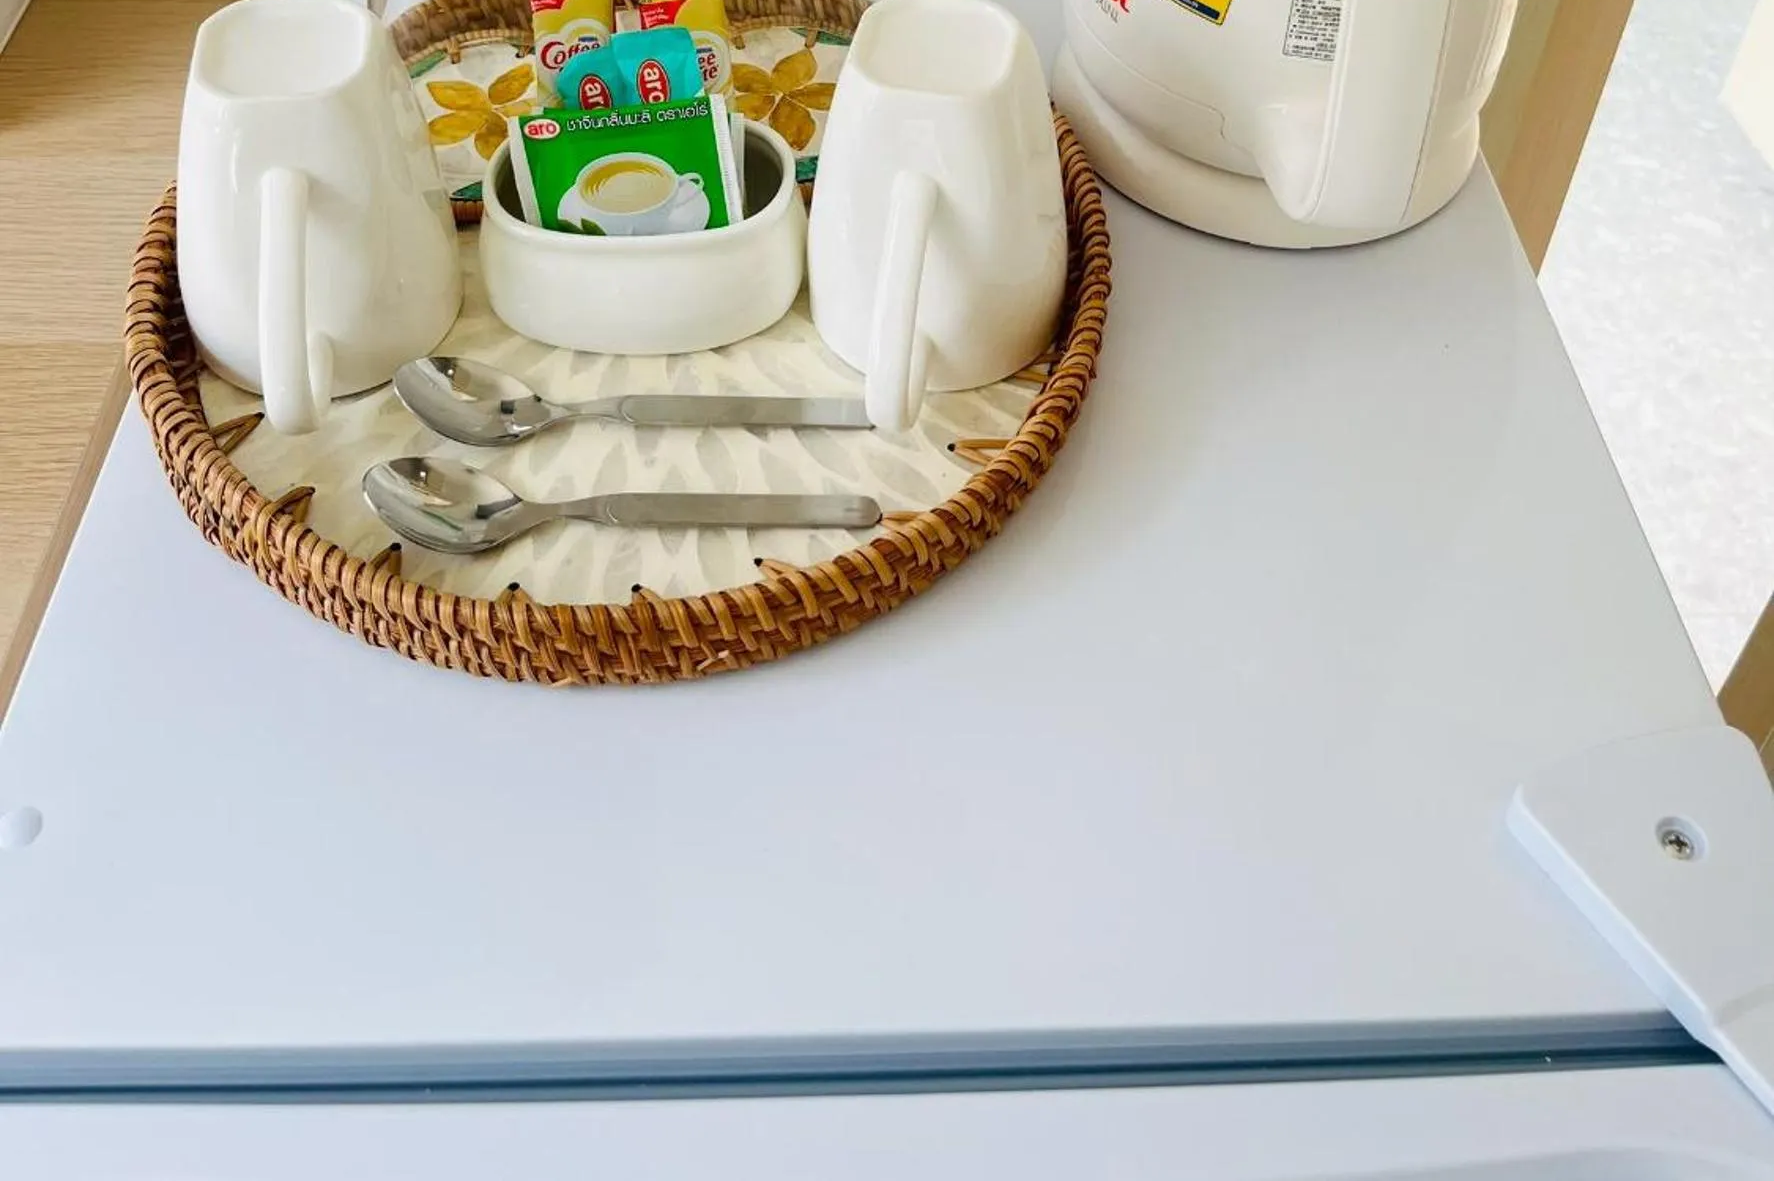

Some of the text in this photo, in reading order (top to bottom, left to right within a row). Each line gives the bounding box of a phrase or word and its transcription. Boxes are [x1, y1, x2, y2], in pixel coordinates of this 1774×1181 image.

[584, 82, 605, 110] ar
[643, 67, 665, 103] aro
[526, 120, 557, 137] aro
